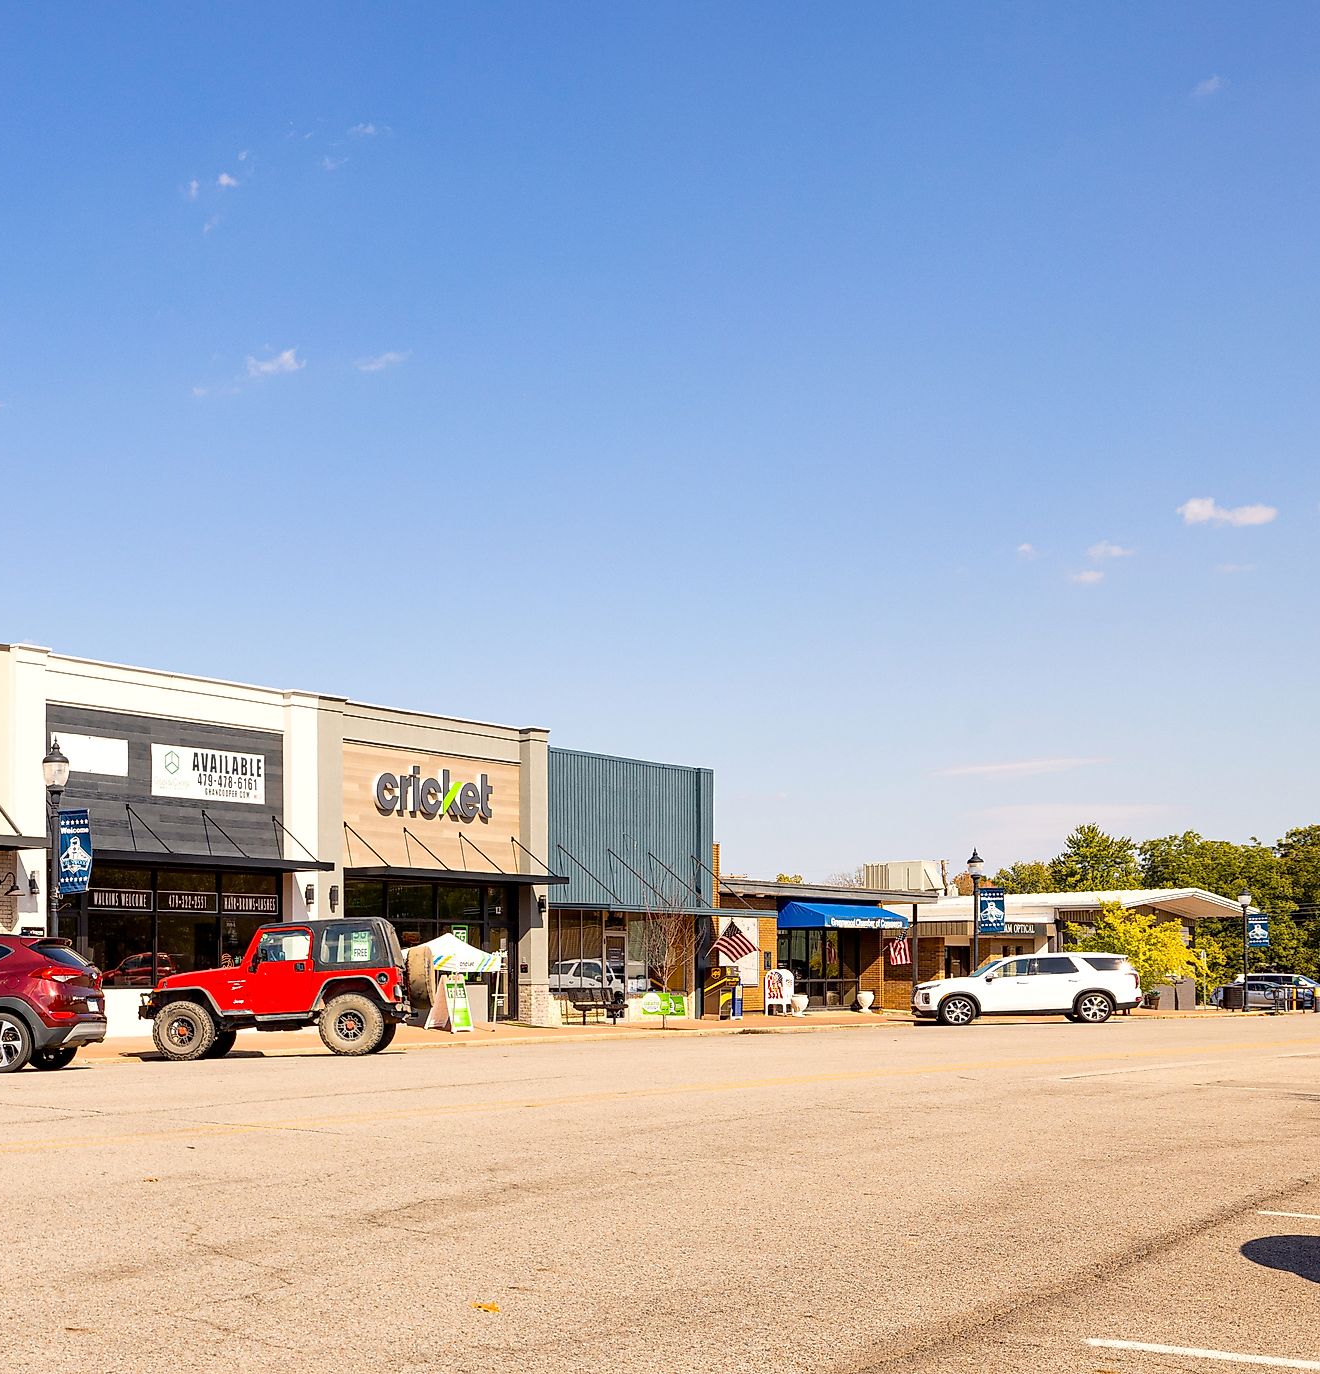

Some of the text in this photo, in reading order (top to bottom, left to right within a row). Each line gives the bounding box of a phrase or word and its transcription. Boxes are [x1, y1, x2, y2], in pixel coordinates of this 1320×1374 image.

[192, 752, 262, 777] AVAILABLE
[197, 774, 257, 790] 479-478-6161
[377, 766, 493, 819] cricket
[60, 826, 89, 834] Welcome
[121, 894, 147, 907] WELCOME
[1014, 924, 1035, 933] OPTICAL
[354, 948, 367, 957] FREE
